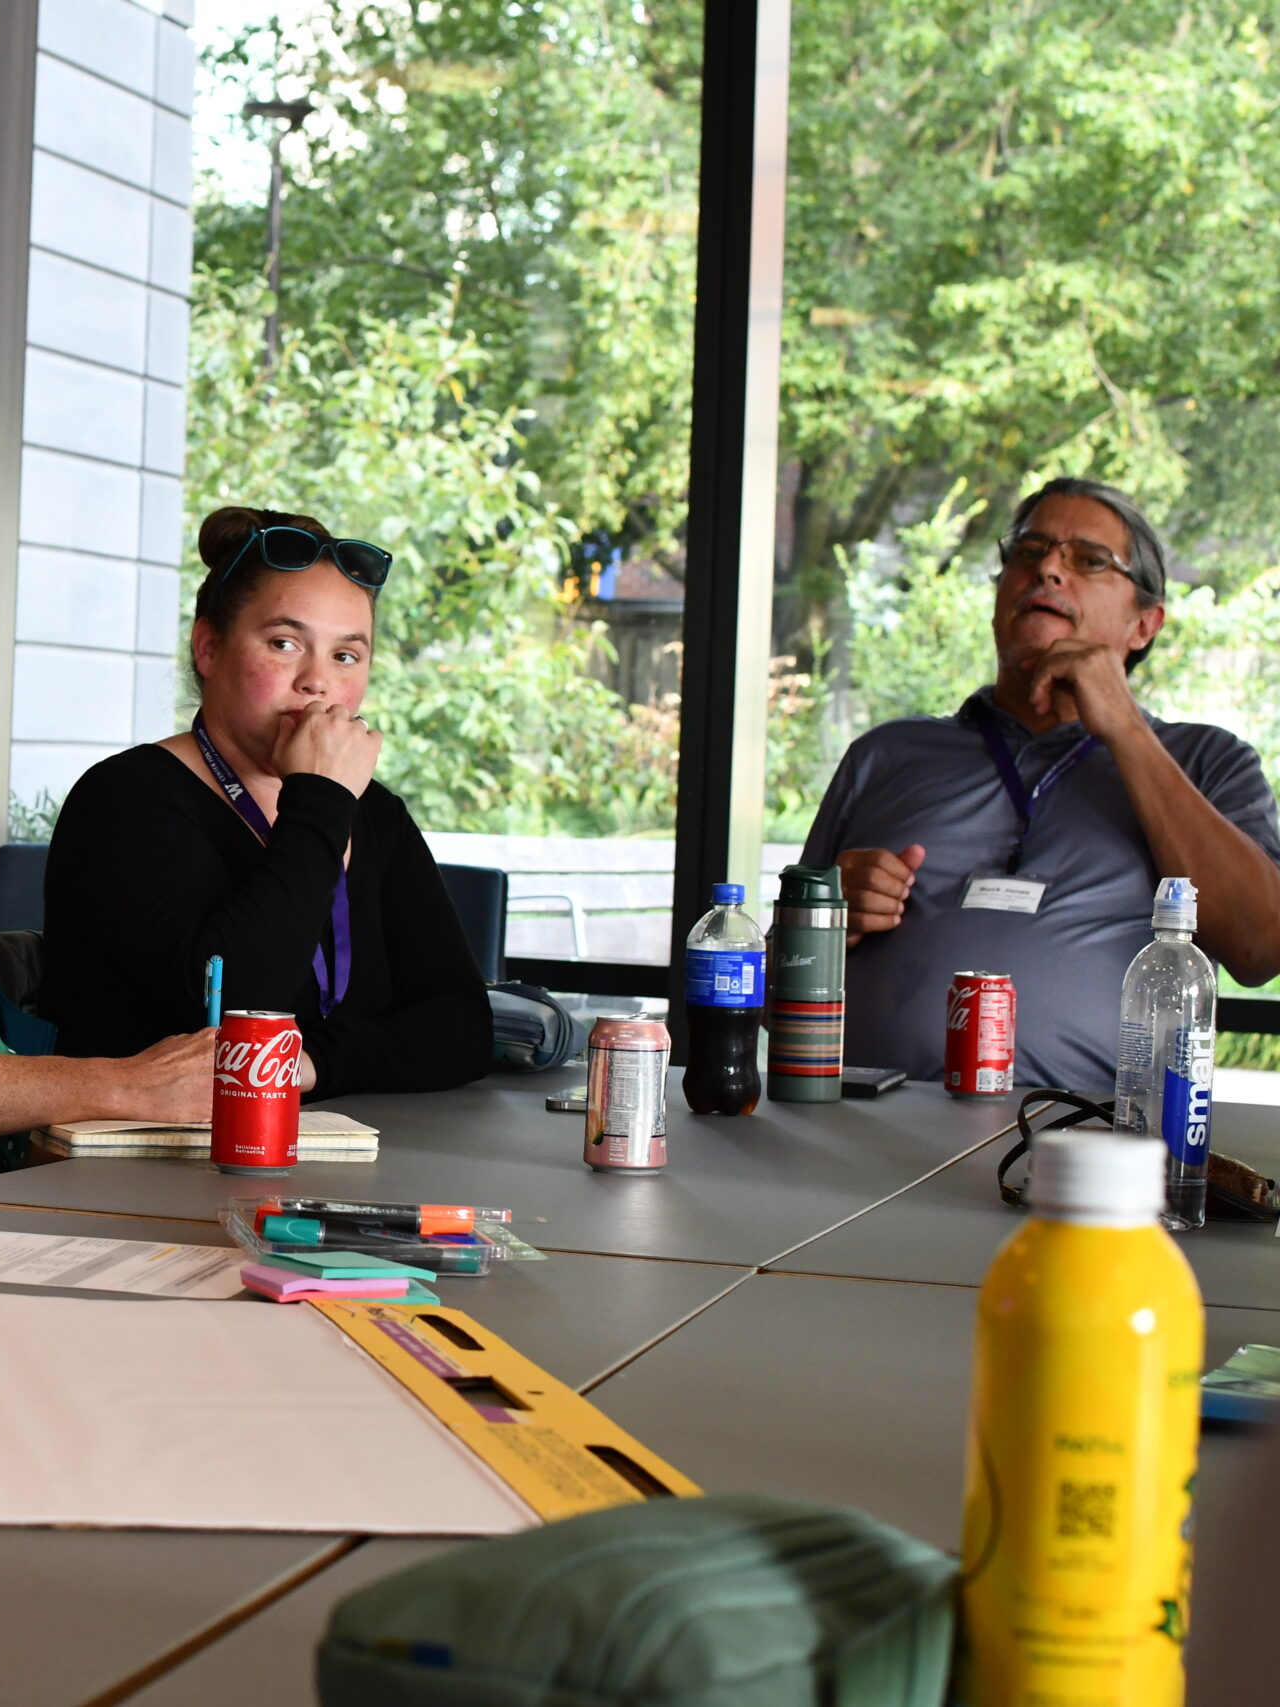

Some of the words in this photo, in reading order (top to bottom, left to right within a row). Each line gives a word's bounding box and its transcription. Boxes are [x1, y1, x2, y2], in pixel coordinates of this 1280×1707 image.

[224, 783, 244, 801] W
[220, 1089, 258, 1099] ORIGINAL
[1186, 1026, 1213, 1147] smart
